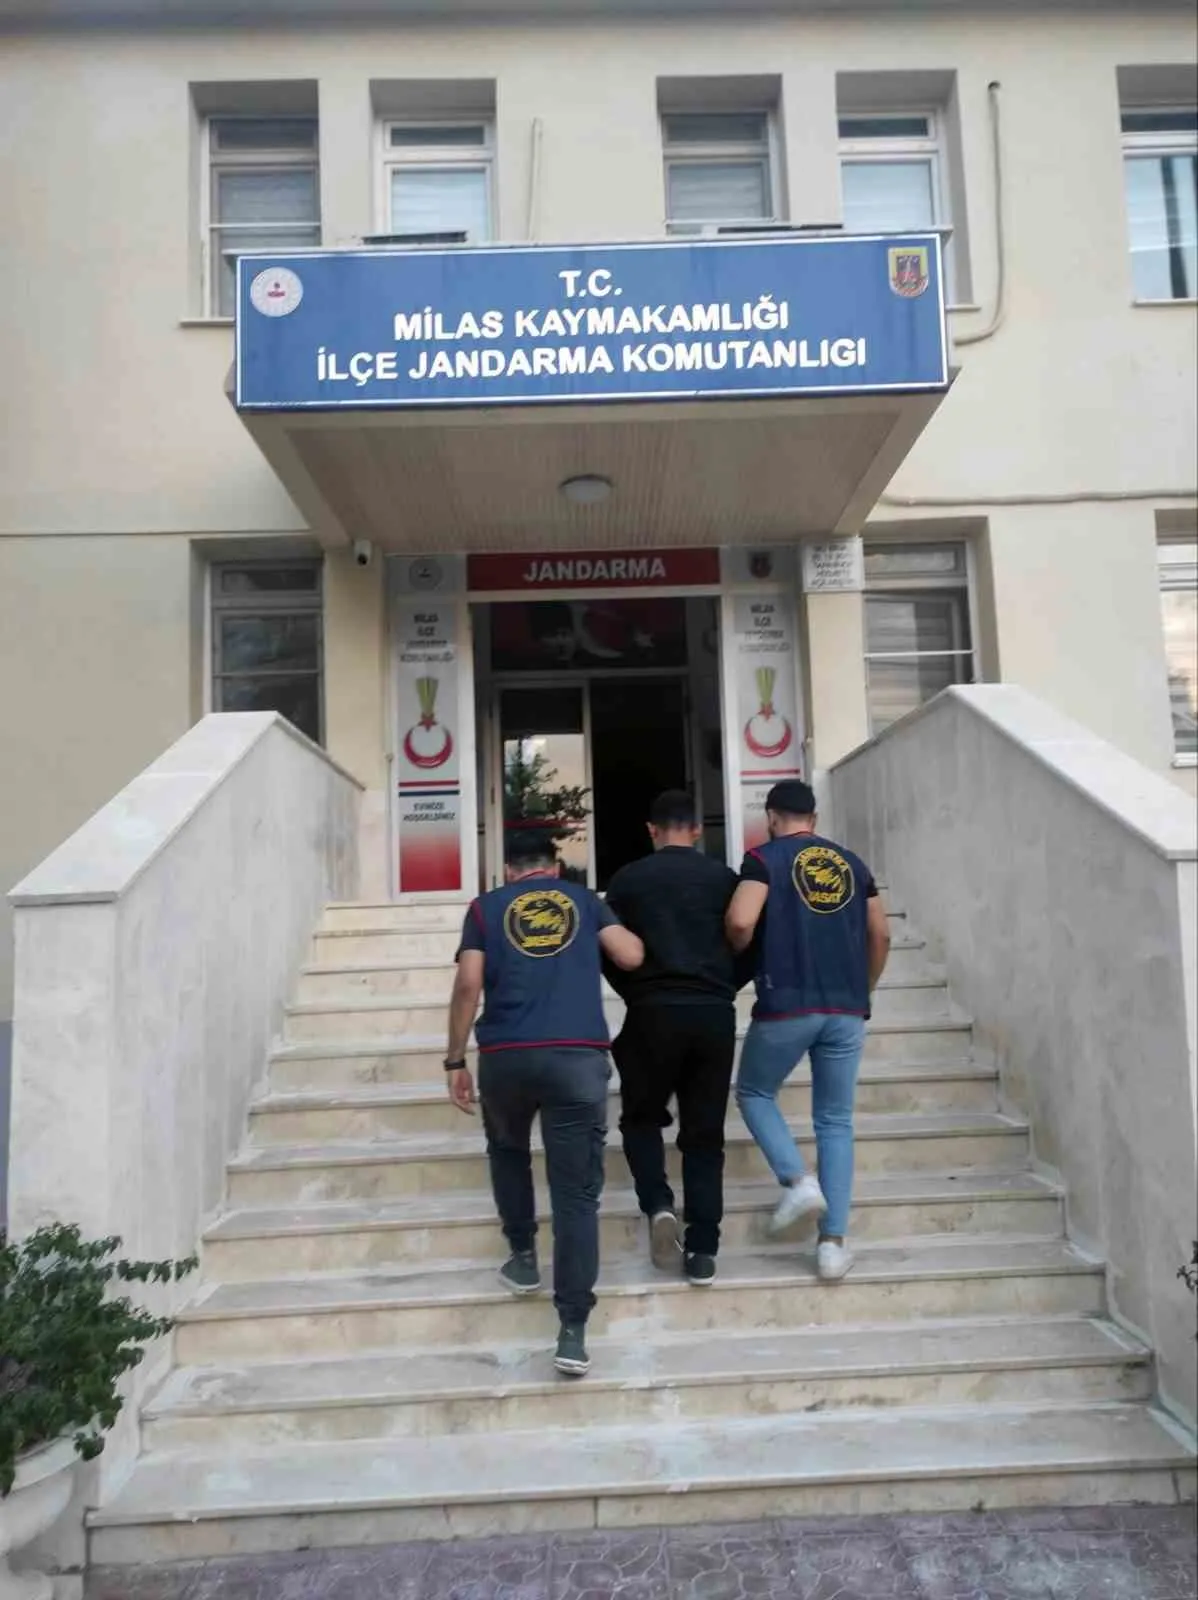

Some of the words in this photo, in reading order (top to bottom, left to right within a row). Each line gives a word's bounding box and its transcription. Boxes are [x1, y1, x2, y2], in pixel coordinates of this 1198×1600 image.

[558, 269, 623, 298] T.C.
[394, 306, 504, 341] MİLAS
[515, 294, 789, 337] KAYMAKAMLIĞI
[317, 347, 399, 387] İLÇE
[408, 345, 614, 380] JANDARMA
[522, 557, 667, 582] JANDARMA
